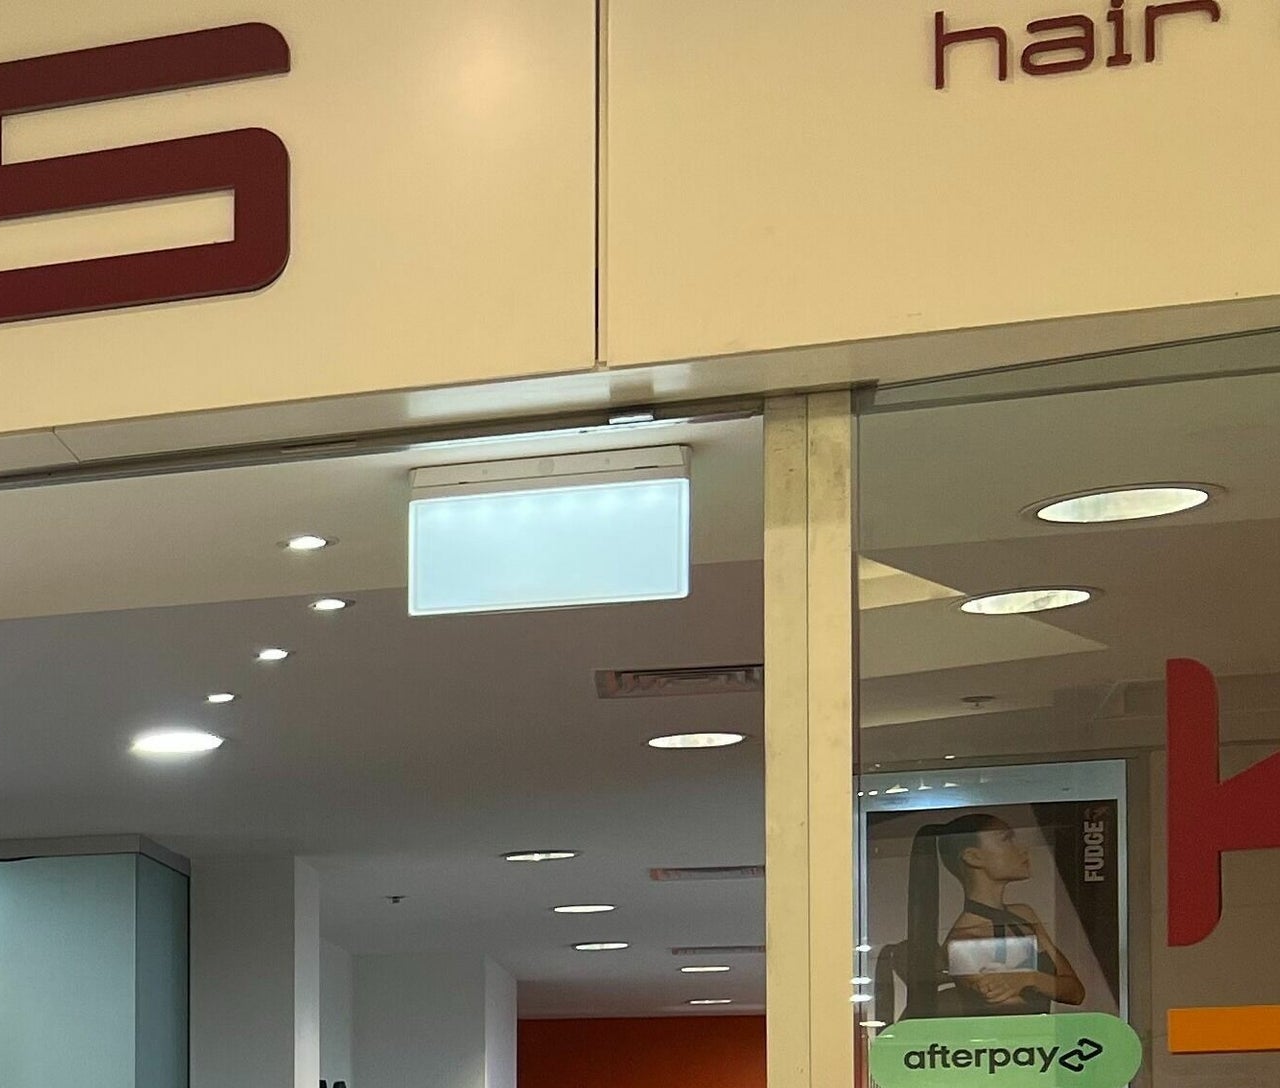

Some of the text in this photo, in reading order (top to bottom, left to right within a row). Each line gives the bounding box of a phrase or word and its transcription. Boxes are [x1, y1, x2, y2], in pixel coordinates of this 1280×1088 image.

[935, 0, 1221, 90] hair
[1084, 819, 1105, 883] FUDGE
[903, 1043, 1060, 1074] afterpay
